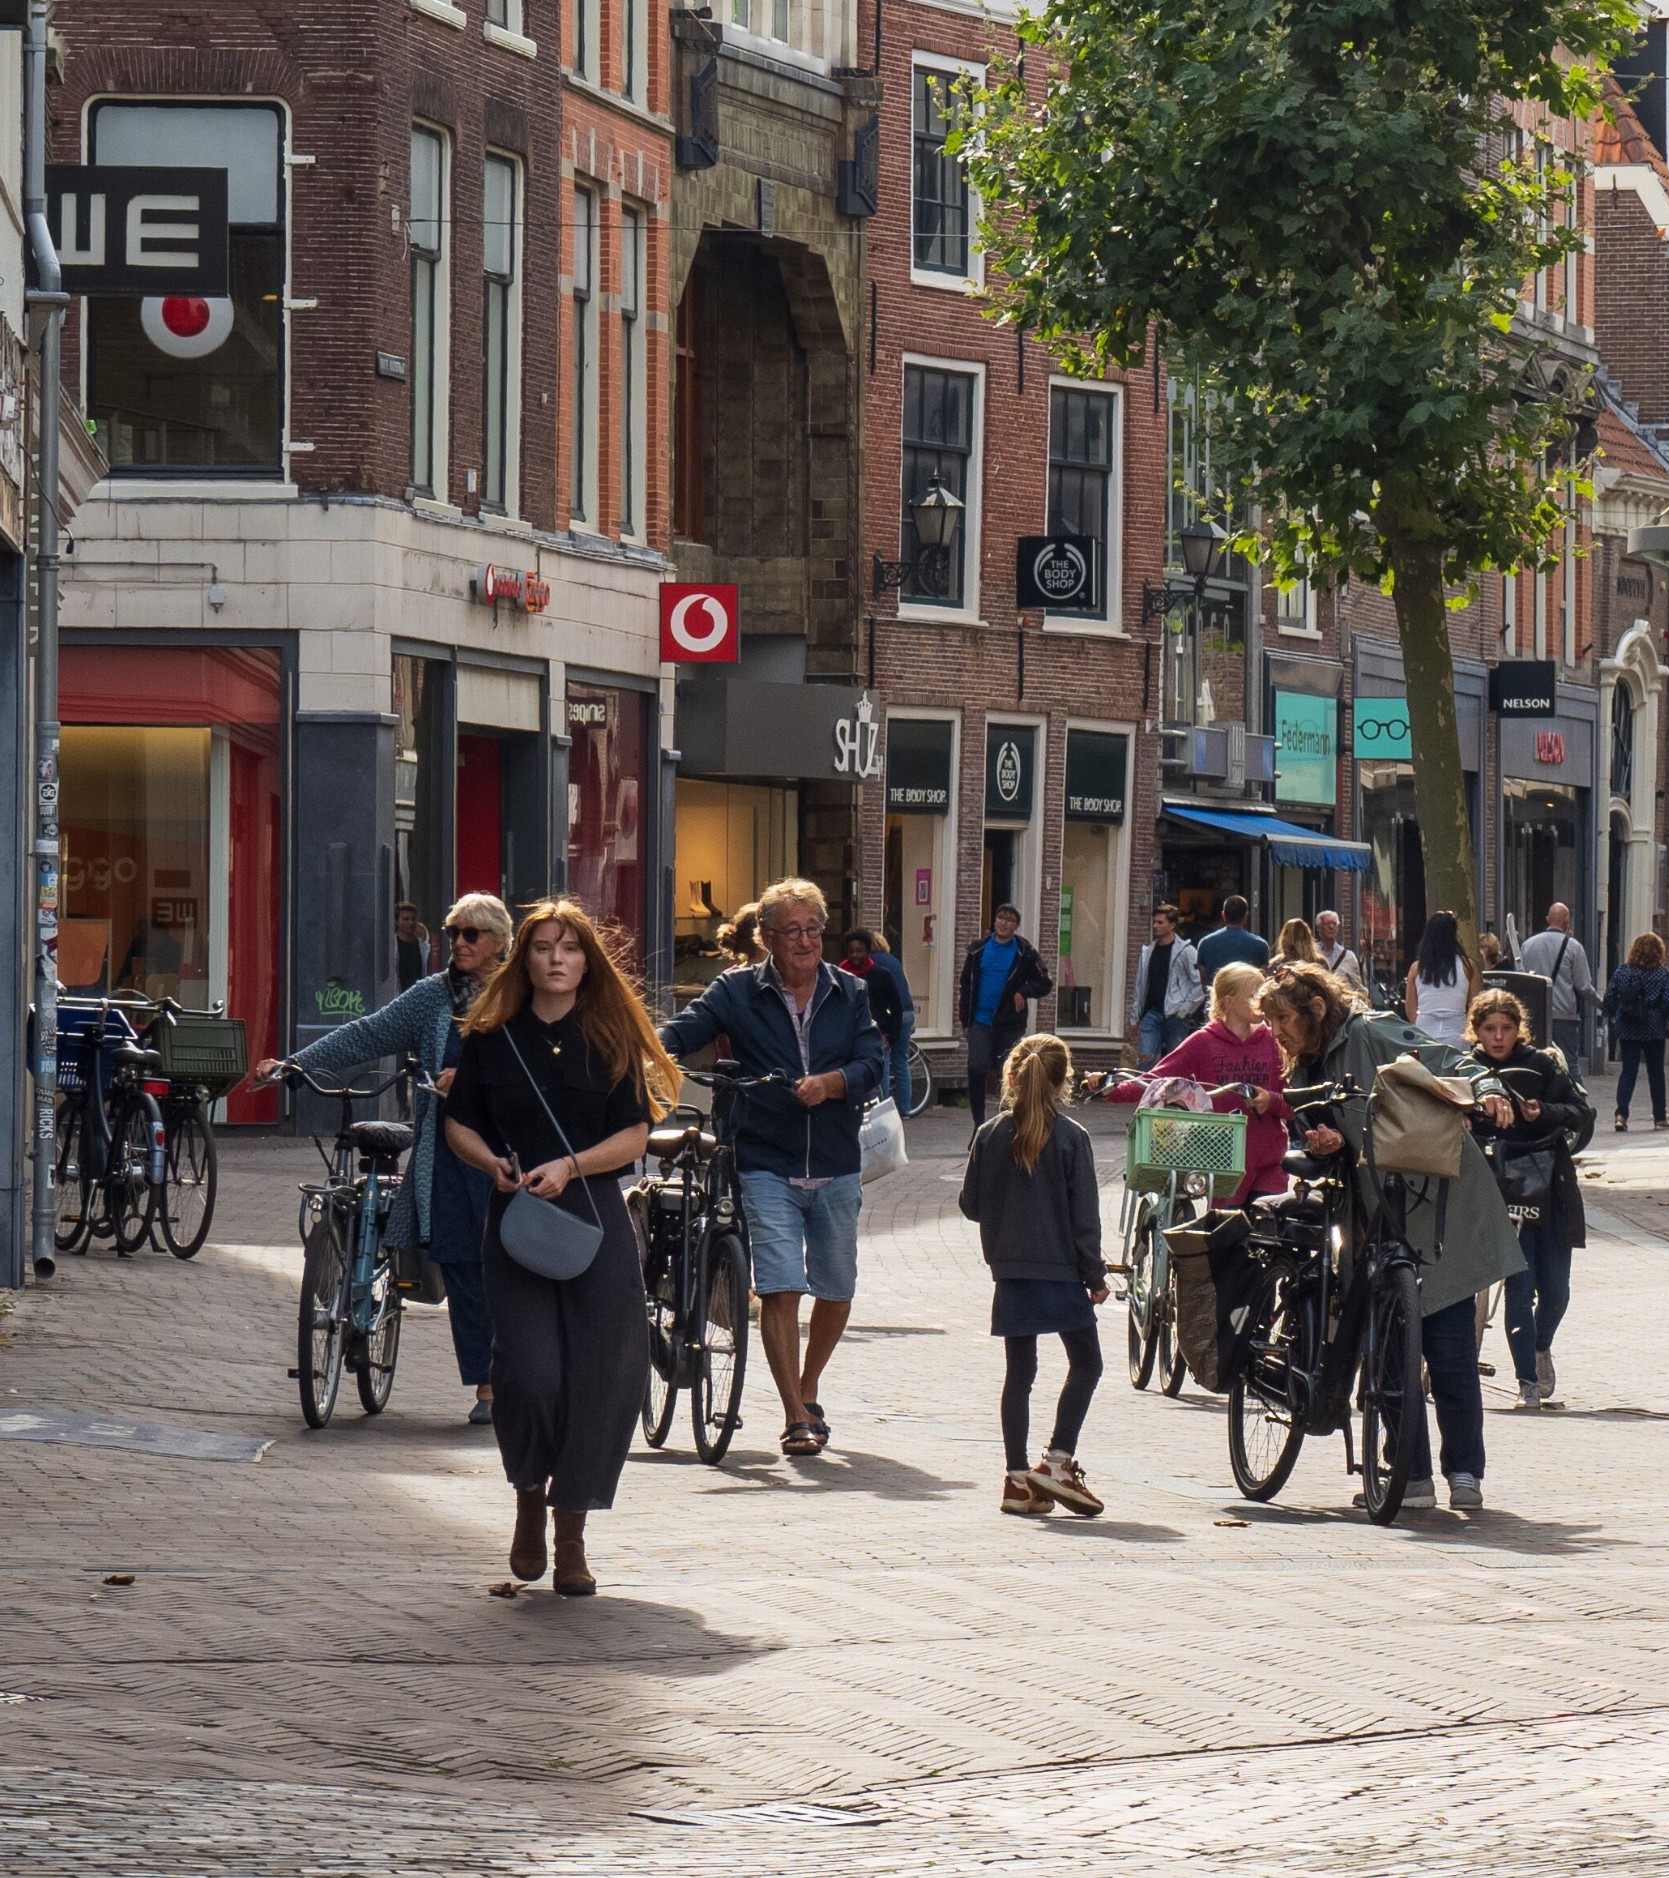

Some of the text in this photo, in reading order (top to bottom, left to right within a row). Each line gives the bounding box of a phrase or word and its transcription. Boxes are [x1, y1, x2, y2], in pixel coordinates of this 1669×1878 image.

[44, 193, 200, 268] WE
[1051, 560, 1069, 569] THE
[1044, 569, 1076, 579] BODY
[1046, 580, 1075, 589] SHOP
[1503, 698, 1550, 709] NELSON
[1282, 719, 1331, 756] Federmann
[1001, 769, 1016, 779] BODY
[1001, 780, 1015, 790] SHOP
[890, 788, 904, 802] THE
[906, 789, 926, 803] BODY
[1069, 796, 1083, 811] THE
[1083, 797, 1102, 812] BODY
[1211, 1055, 1270, 1074] Fashion
